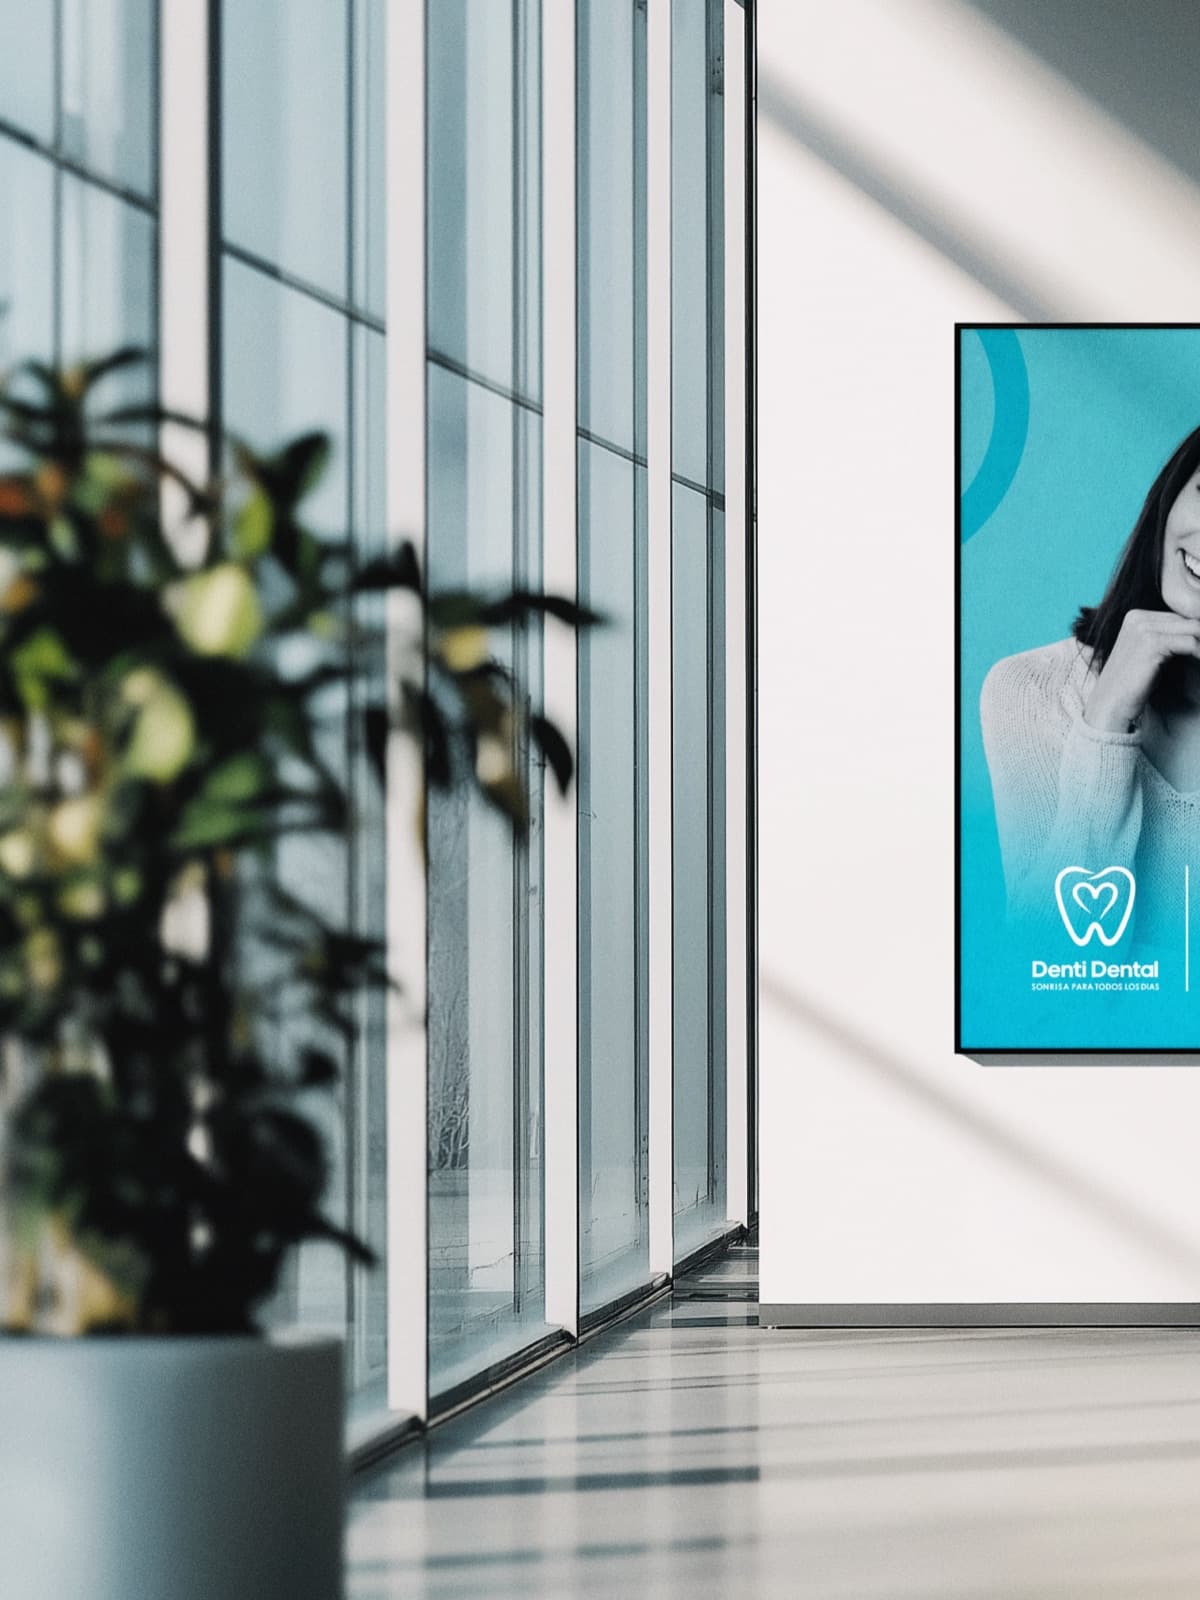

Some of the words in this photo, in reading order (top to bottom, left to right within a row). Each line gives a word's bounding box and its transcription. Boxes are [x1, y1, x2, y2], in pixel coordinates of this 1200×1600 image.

[1031, 960, 1087, 978] Denti
[1090, 960, 1159, 978] Dental
[1031, 983, 1070, 991] SONRISA
[1071, 983, 1093, 991] PARA
[1094, 983, 1122, 991] TODOS
